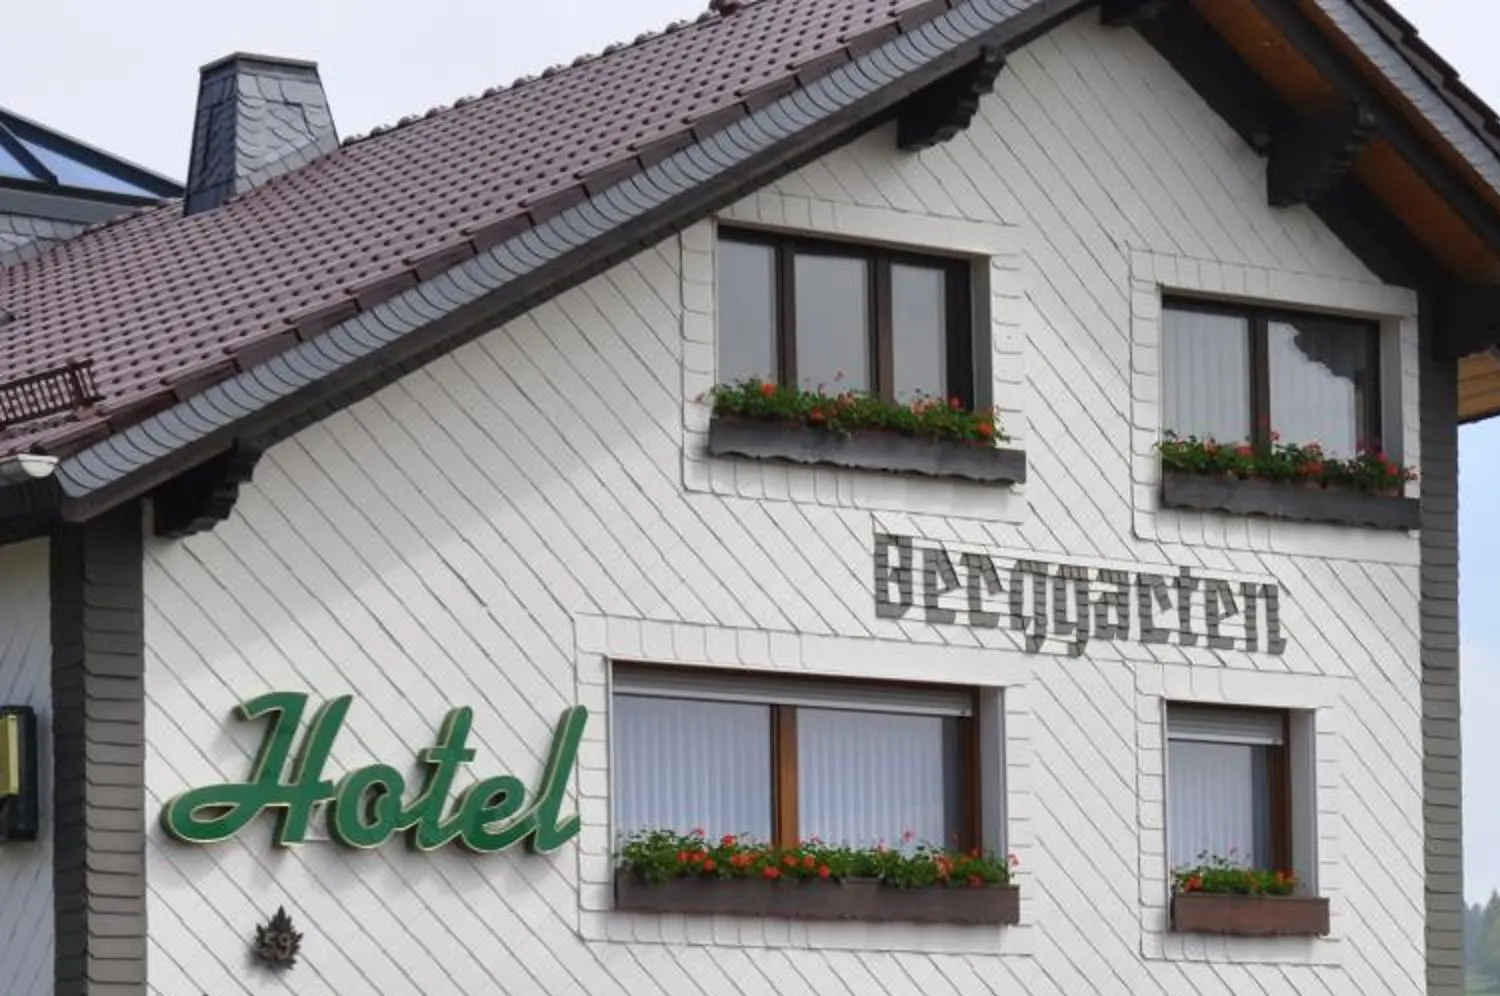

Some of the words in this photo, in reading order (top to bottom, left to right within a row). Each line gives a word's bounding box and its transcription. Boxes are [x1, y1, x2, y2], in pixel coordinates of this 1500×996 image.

[874, 533, 1287, 657] Berggarten
[161, 691, 589, 853] Hotel
[260, 931, 292, 960] 59
